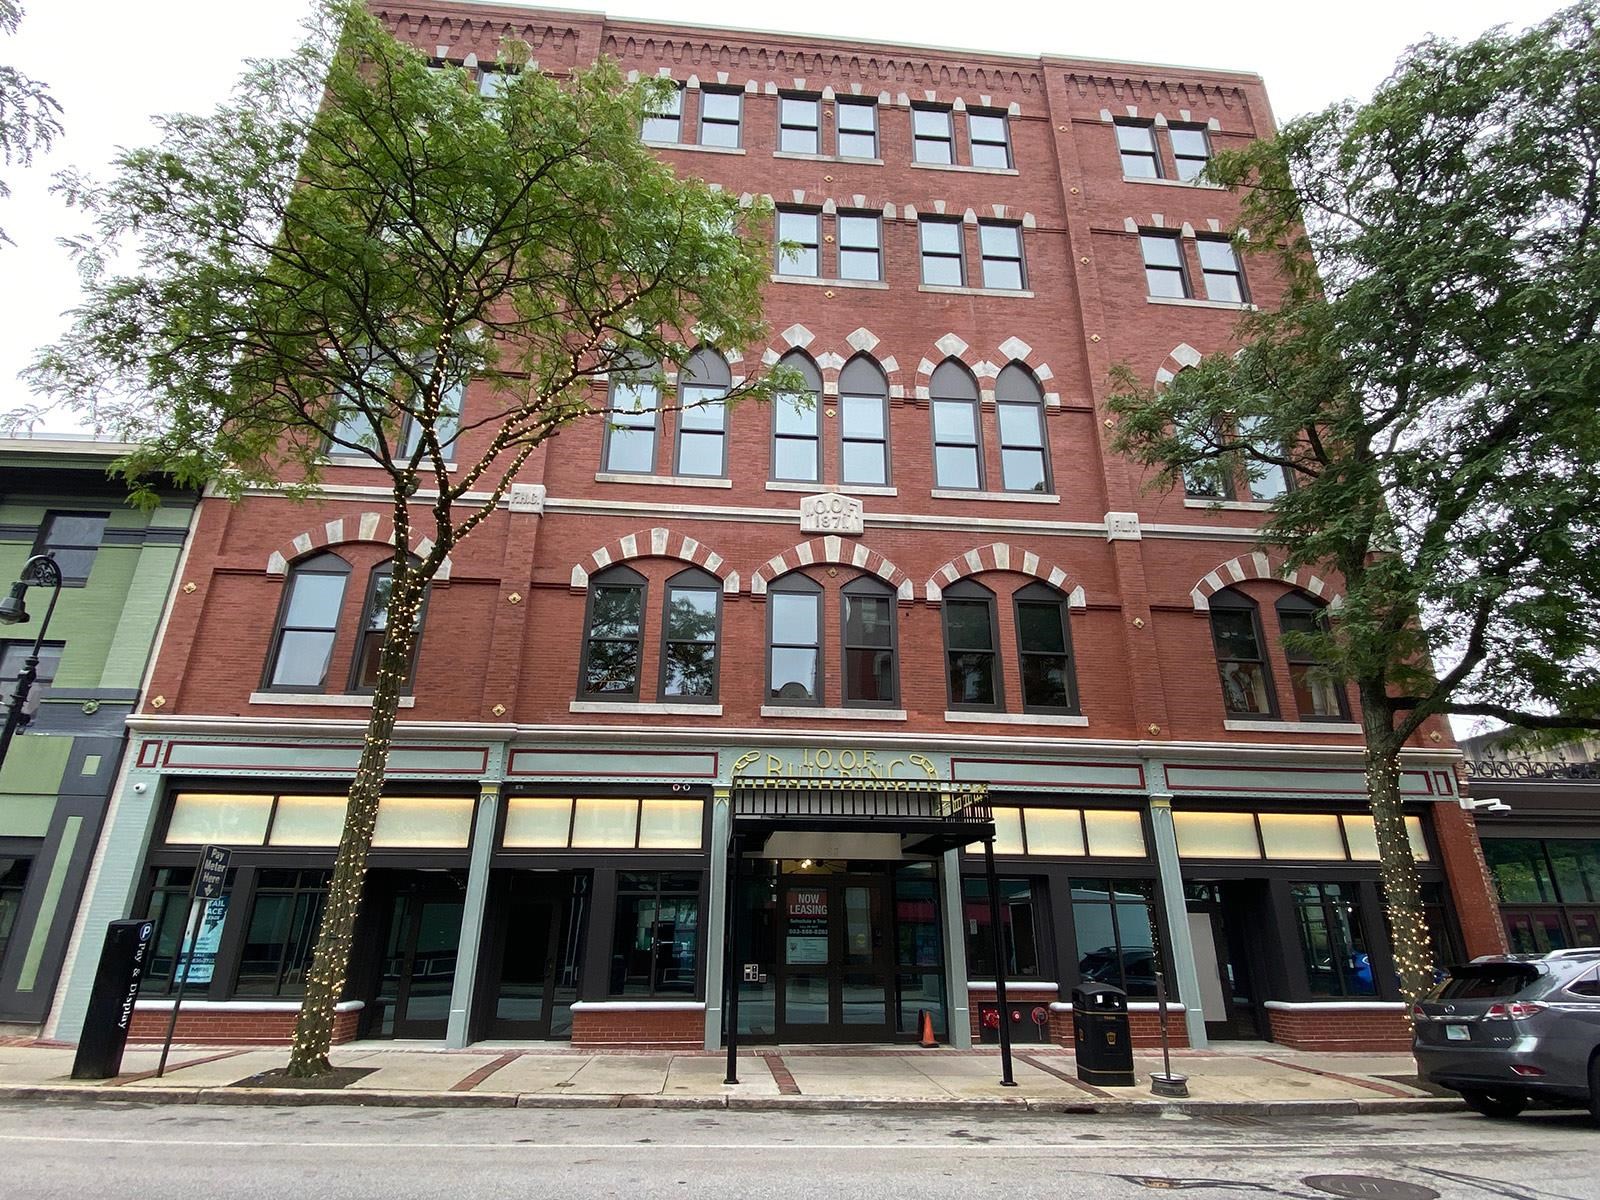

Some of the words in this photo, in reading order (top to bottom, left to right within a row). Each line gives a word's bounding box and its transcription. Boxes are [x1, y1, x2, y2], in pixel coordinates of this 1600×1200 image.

[211, 848, 225, 862] Pay
[204, 859, 226, 872] Meter
[202, 871, 220, 884] Here
[798, 894, 820, 904] NOW
[789, 904, 828, 915] LEASING
[134, 943, 146, 962] Pay
[132, 967, 141, 978] &
[118, 983, 138, 1029] Display
